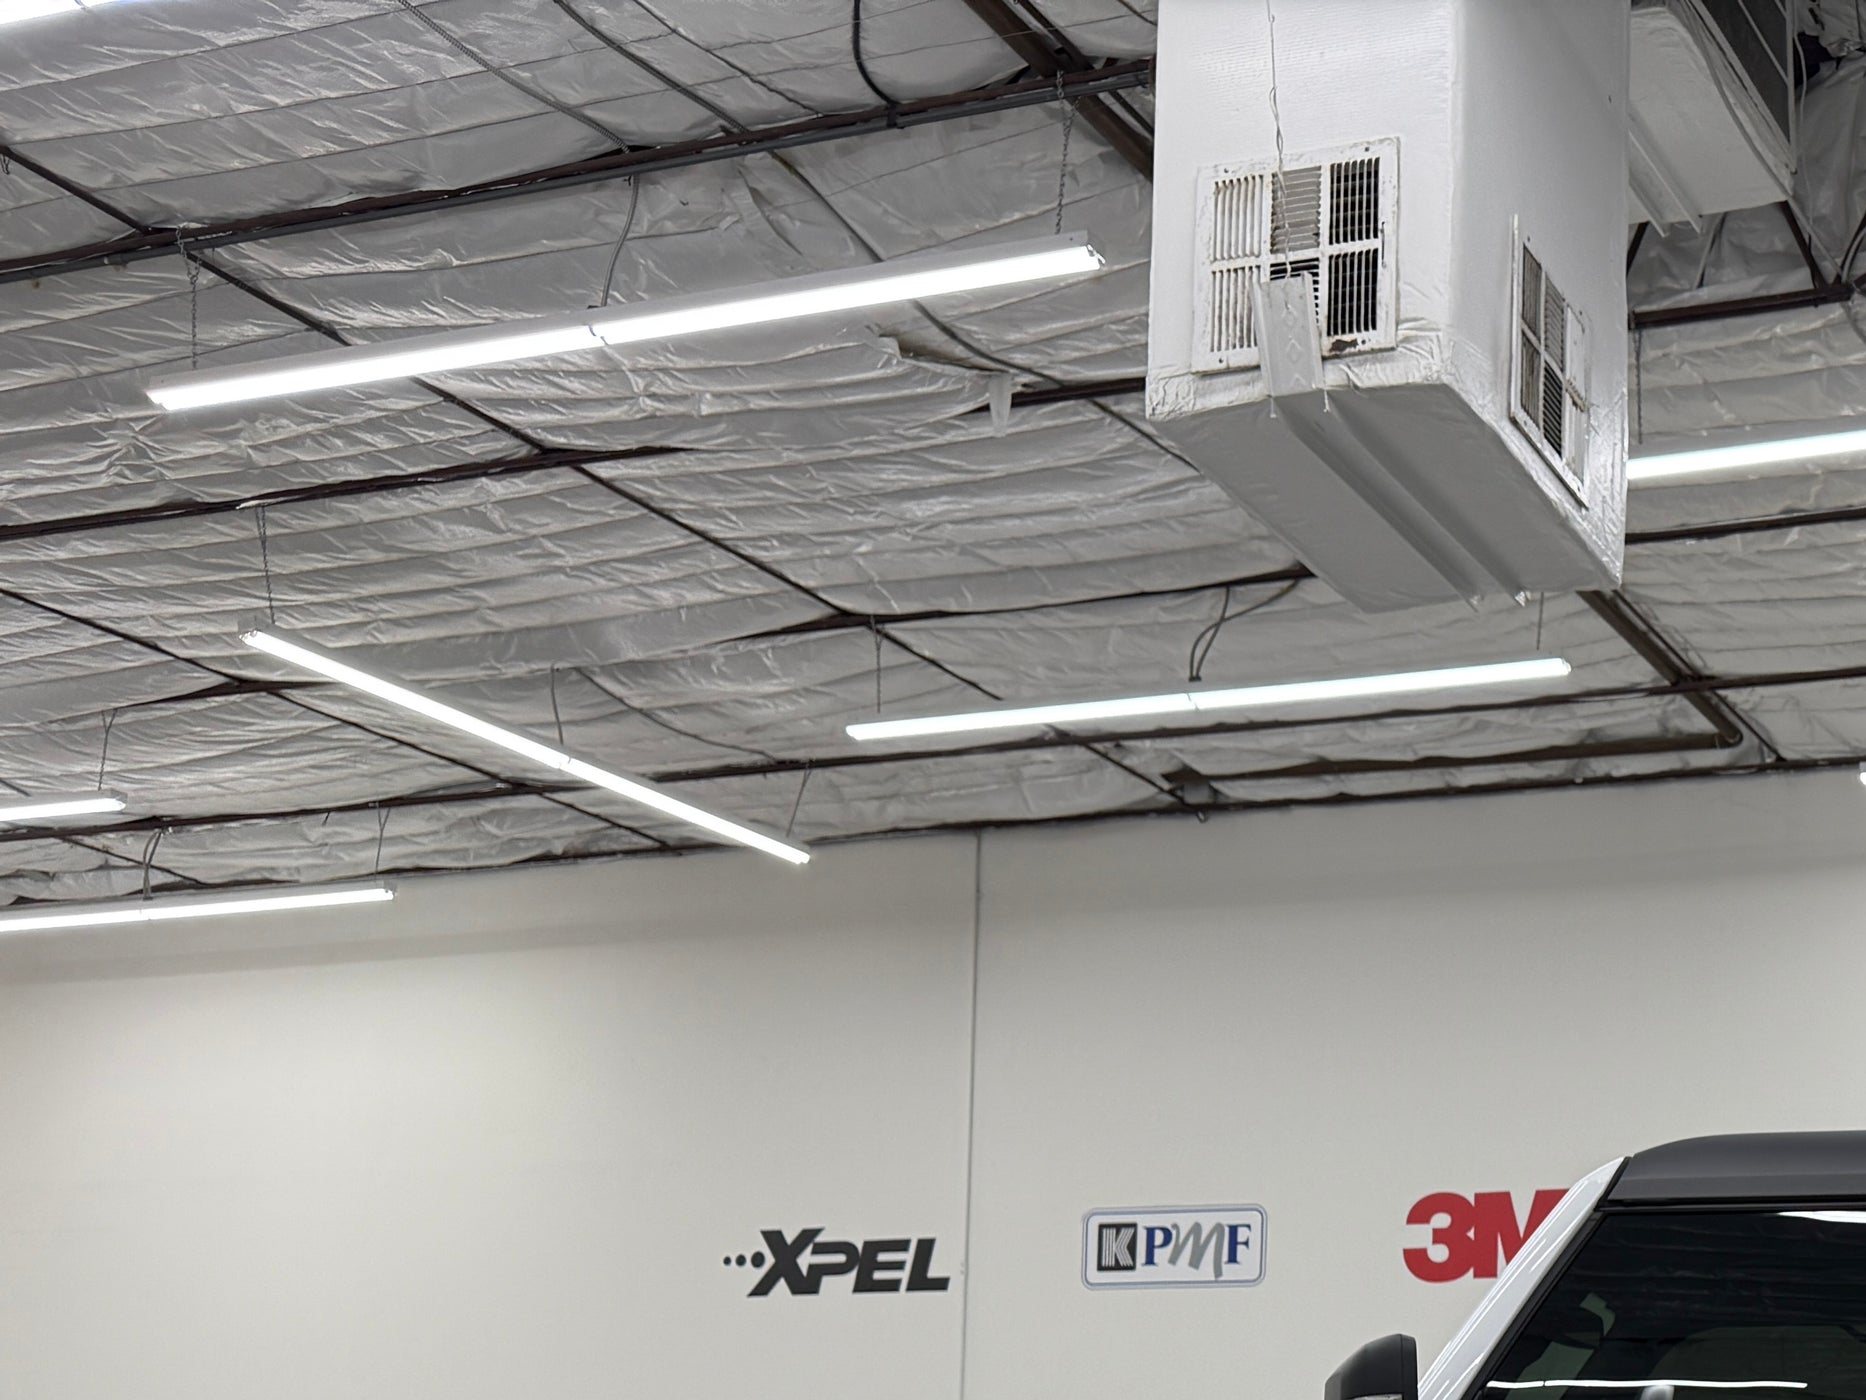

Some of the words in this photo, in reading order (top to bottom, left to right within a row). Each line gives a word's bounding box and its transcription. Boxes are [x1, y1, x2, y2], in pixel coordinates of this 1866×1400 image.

[747, 1228, 950, 1297] XPEL
[1098, 1221, 1253, 1281] KPMF
[1403, 1189, 1568, 1284] 3M
